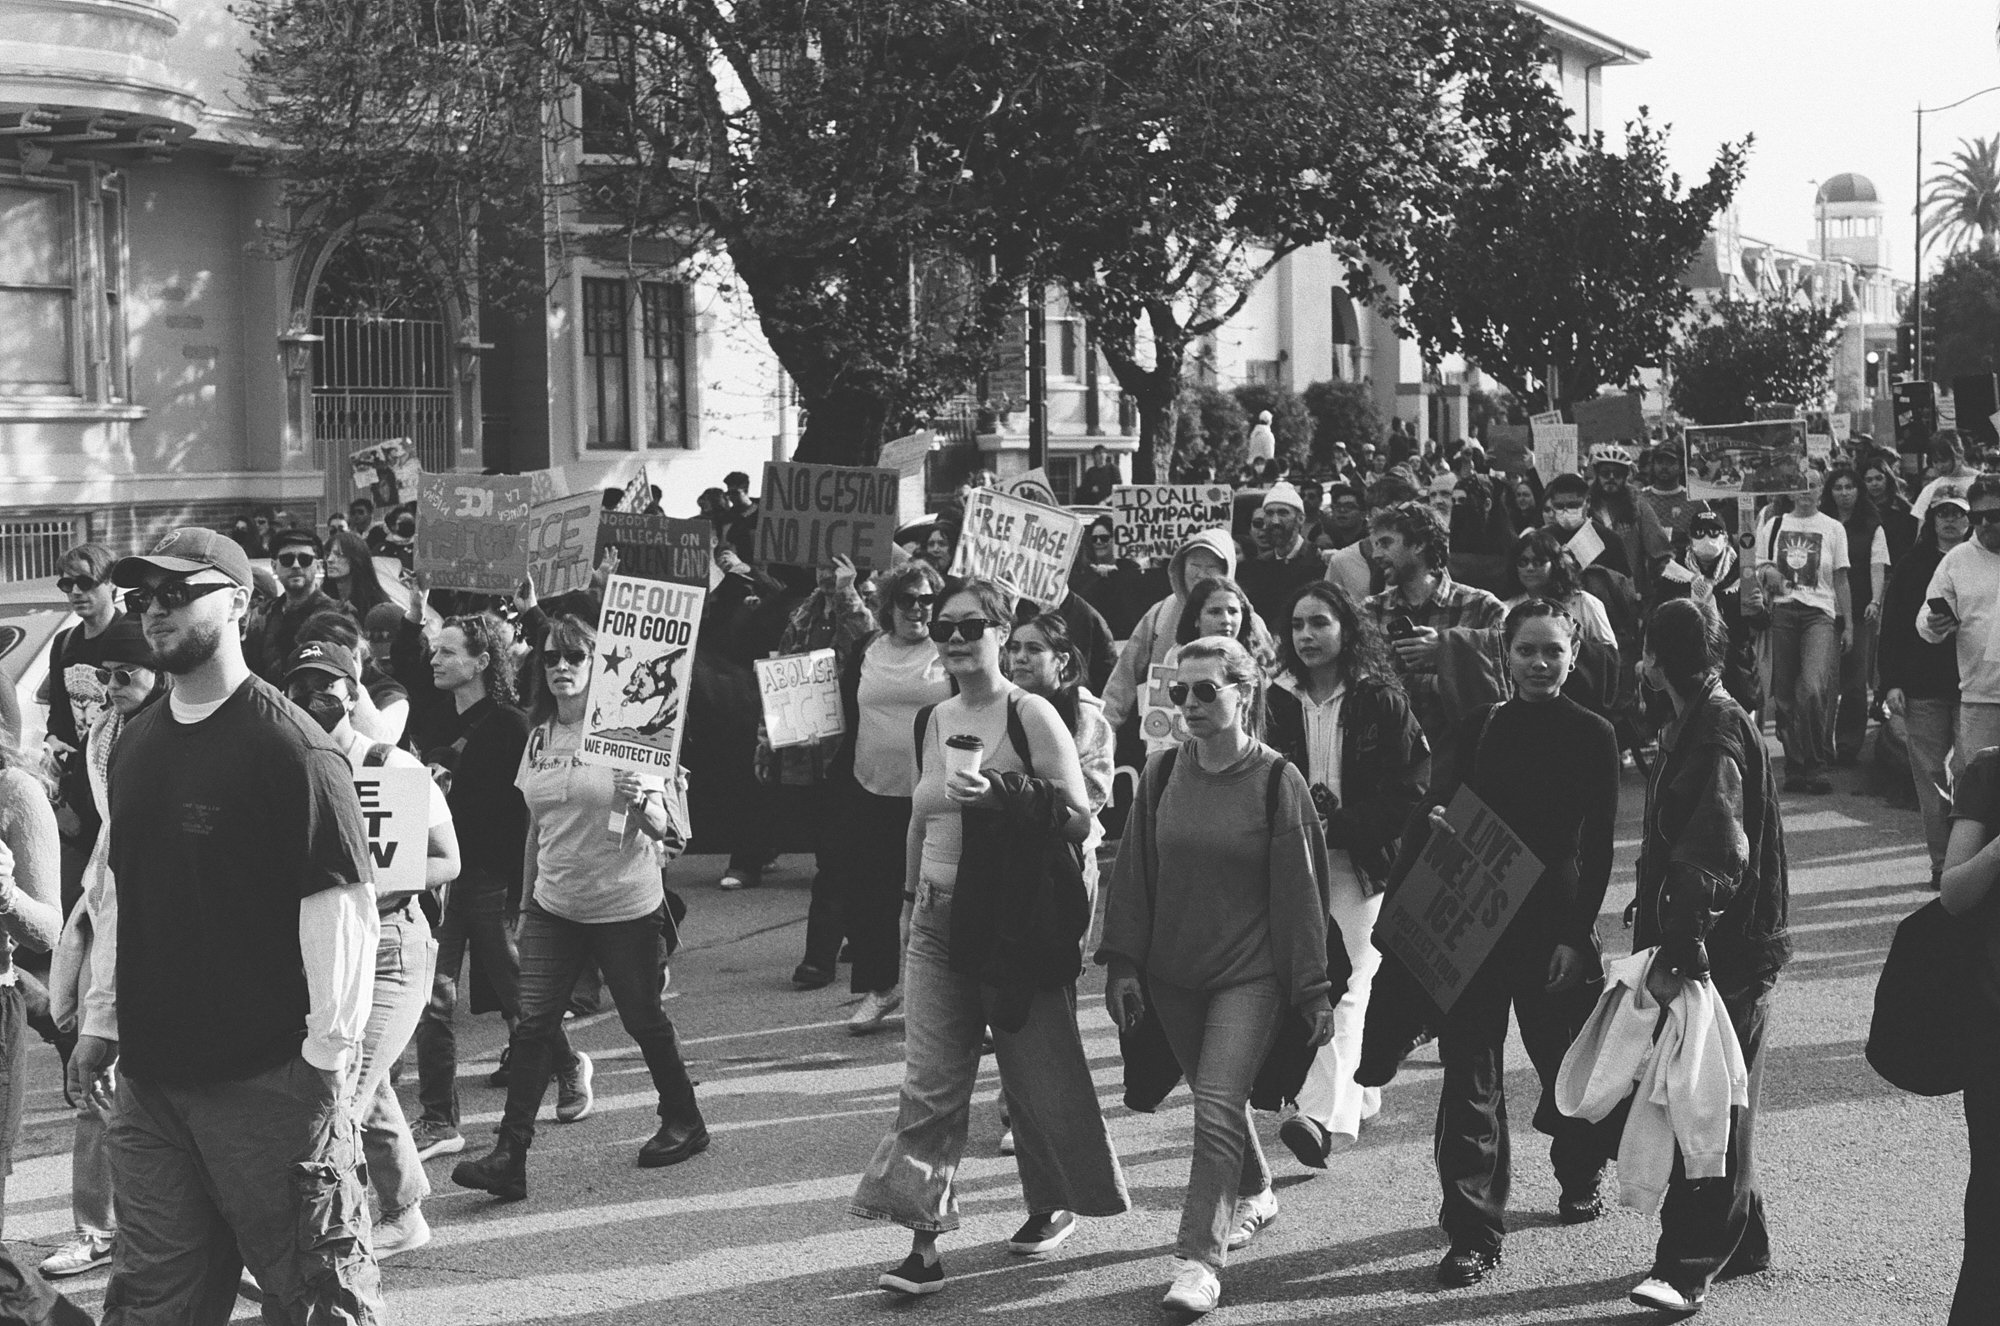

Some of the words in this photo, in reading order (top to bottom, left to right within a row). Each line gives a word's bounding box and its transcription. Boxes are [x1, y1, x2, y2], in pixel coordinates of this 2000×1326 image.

[454, 486, 494, 517] ICE
[504, 488, 520, 503] LA
[766, 466, 811, 511] NO
[815, 470, 899, 515] GESTAPO
[1156, 487, 1203, 506] CALL
[600, 513, 650, 528] NOBODY
[659, 517, 670, 530] IS
[969, 494, 1015, 541] FREE
[1020, 513, 1068, 559] THOSE
[1119, 505, 1177, 524] TRUMP
[615, 528, 672, 546] ILLEGAL
[680, 533, 700, 546] ON
[761, 517, 800, 562] NO
[808, 519, 876, 567] ICE
[1115, 525, 1148, 545] BUT
[1150, 525, 1174, 540] HE
[673, 547, 710, 579] LAND
[607, 581, 646, 612] ICE
[646, 586, 699, 620] OUT
[602, 609, 637, 638] FOR
[639, 615, 692, 646] GOOD
[764, 656, 837, 694] ABOLISH
[768, 681, 841, 743] ICE
[584, 738, 601, 754] WE
[602, 742, 652, 763] PROTECT
[654, 752, 671, 767] US
[1461, 807, 1524, 883] LOVE
[1422, 829, 1510, 930] MELTS
[1422, 883, 1477, 952] ICE
